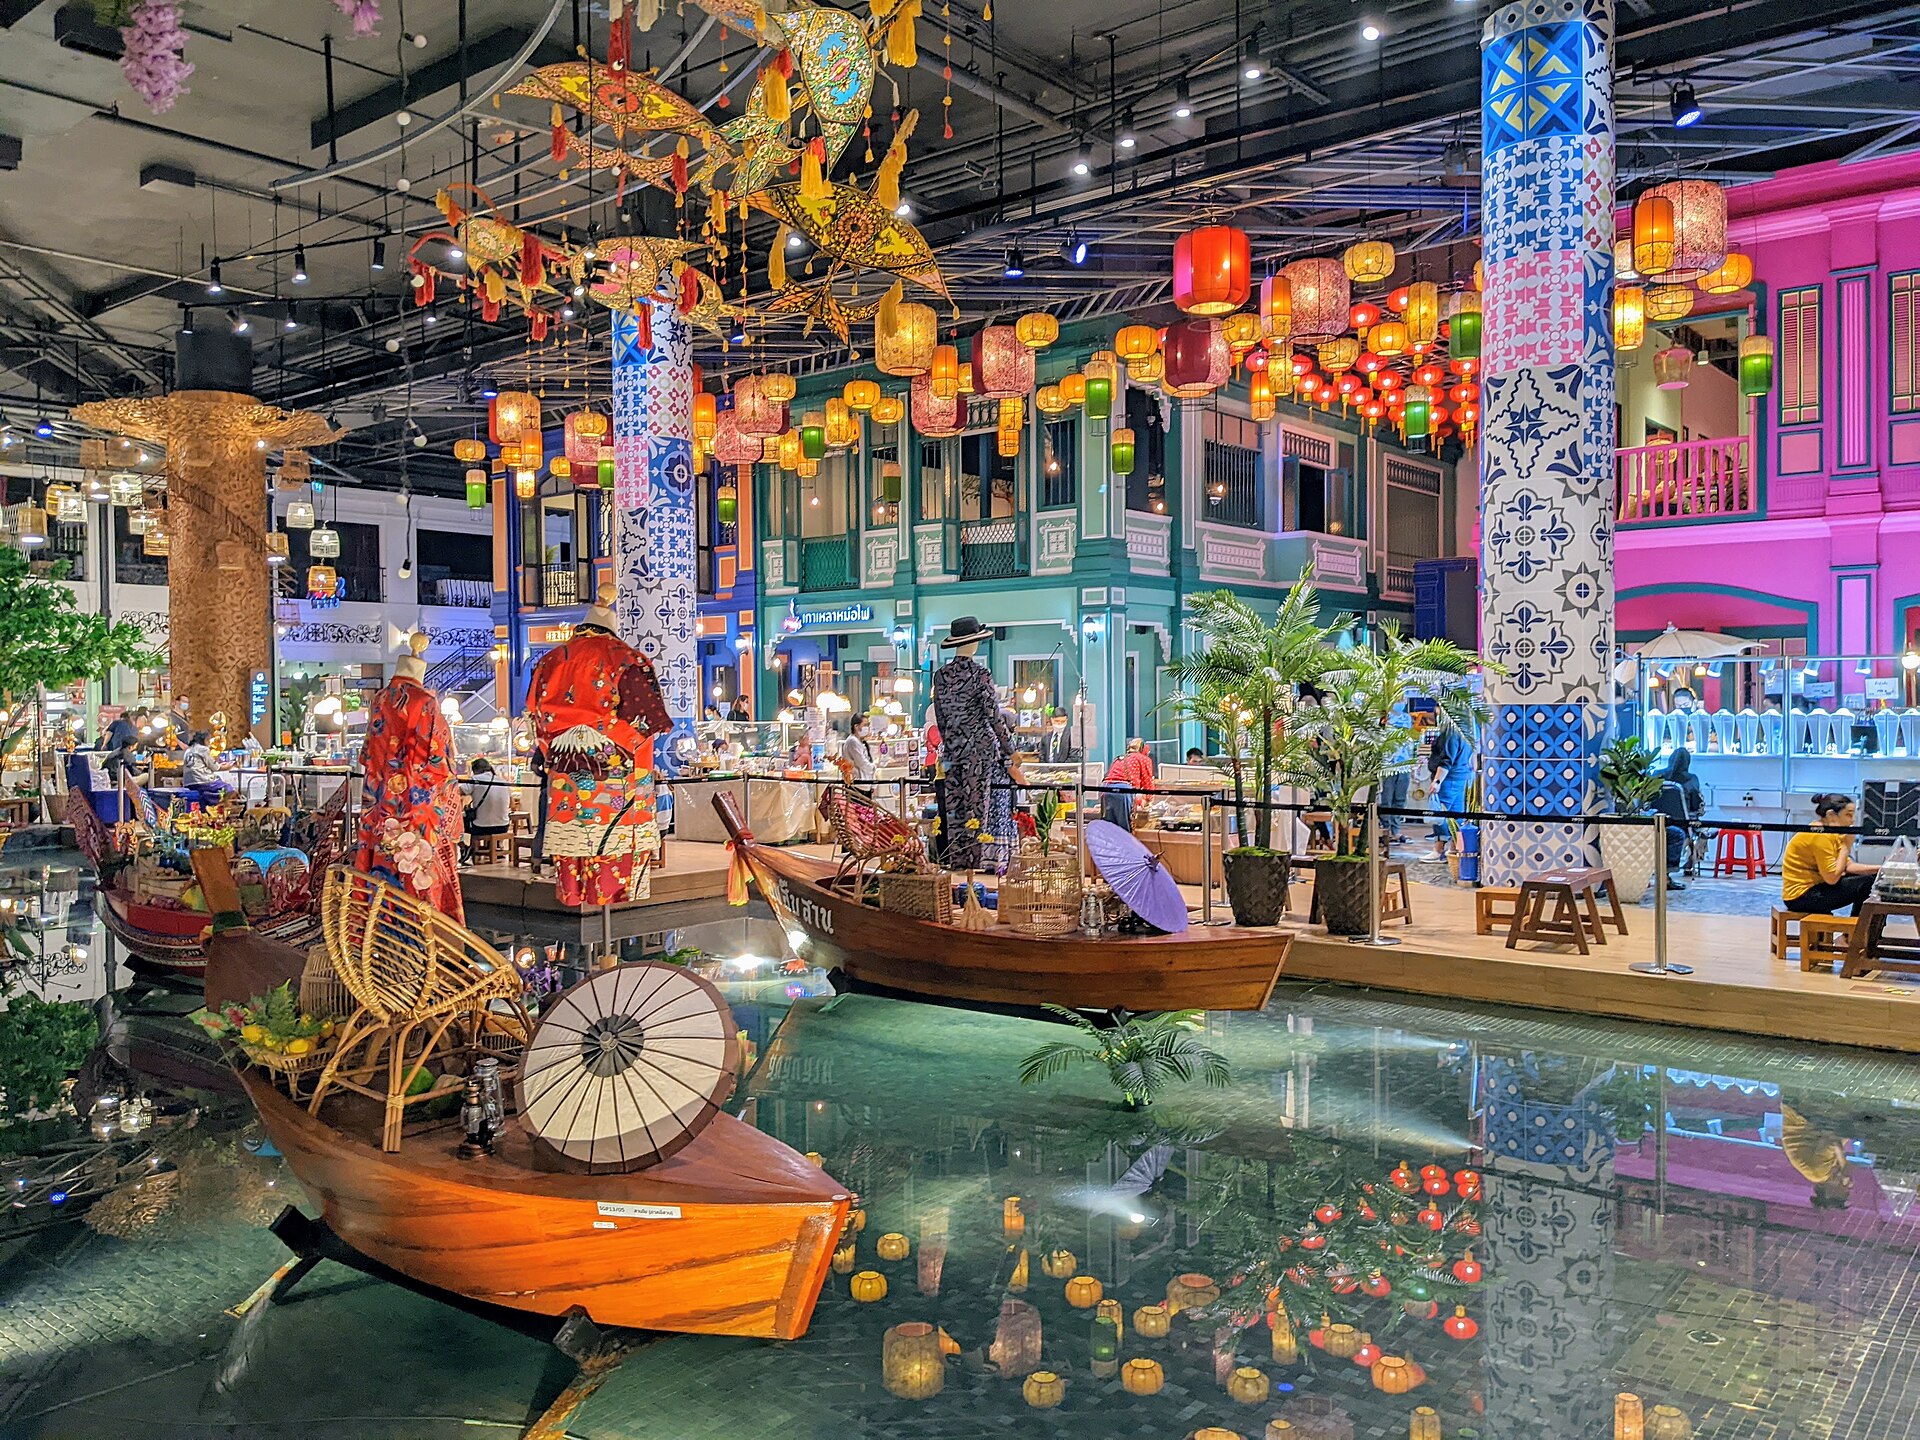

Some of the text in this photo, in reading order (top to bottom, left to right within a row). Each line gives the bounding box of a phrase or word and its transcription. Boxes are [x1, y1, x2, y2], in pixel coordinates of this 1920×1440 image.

[802, 603, 871, 624] เกาเหลาหม้อไฟ
